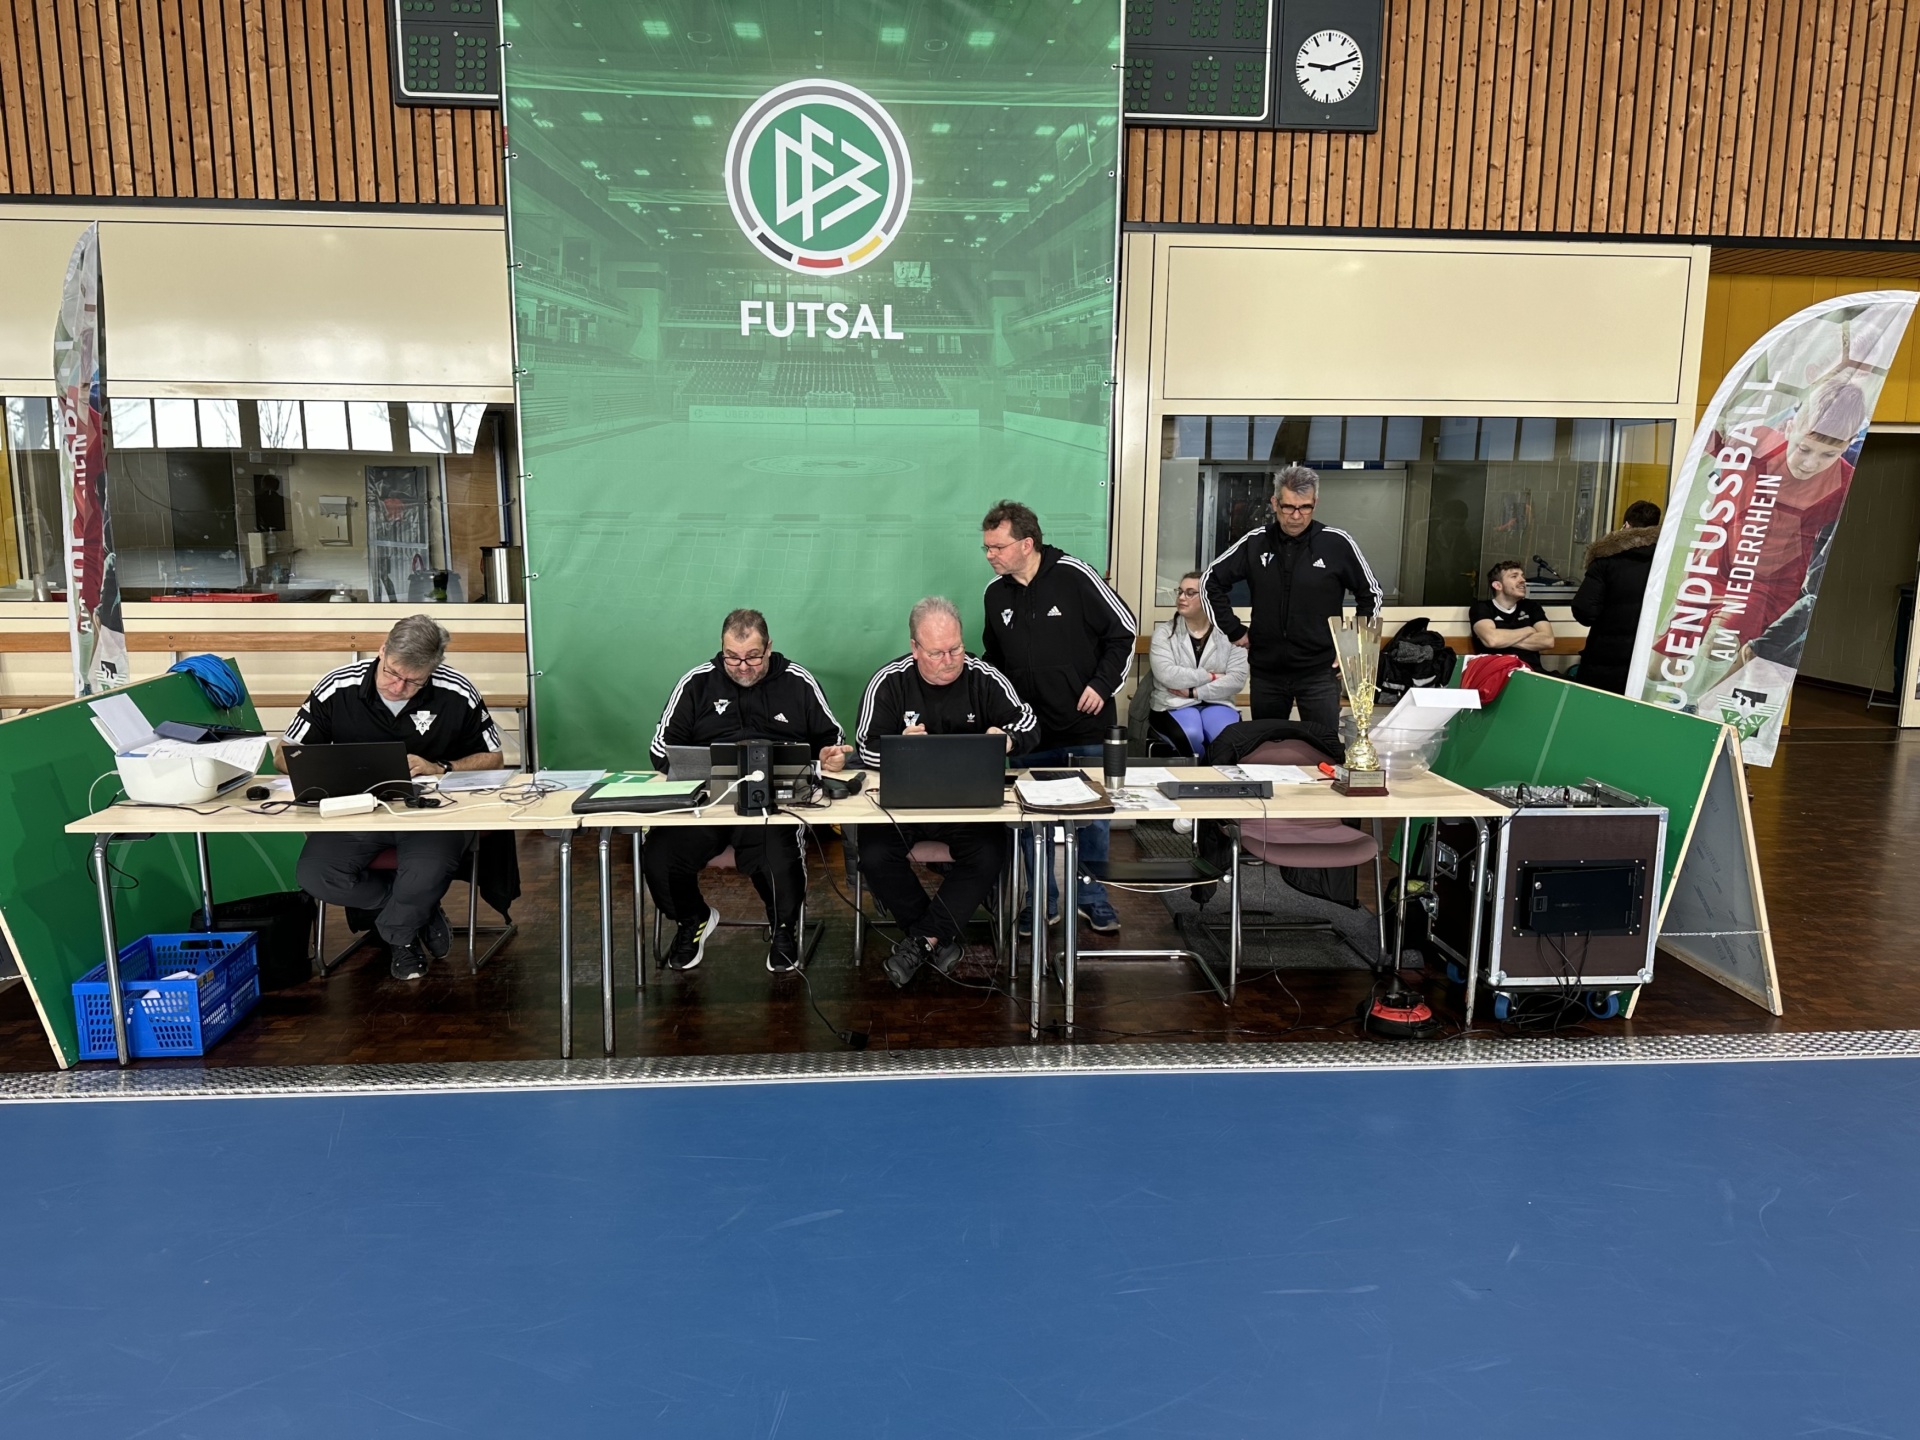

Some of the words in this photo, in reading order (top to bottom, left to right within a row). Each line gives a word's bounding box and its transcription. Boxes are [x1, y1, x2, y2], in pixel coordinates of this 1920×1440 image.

[740, 300, 904, 340] FUTSAL
[1653, 370, 1782, 711] UGENDFUSSBALL
[1720, 474, 1783, 615] NIEDERRHEIN
[1710, 628, 1741, 662] AM
